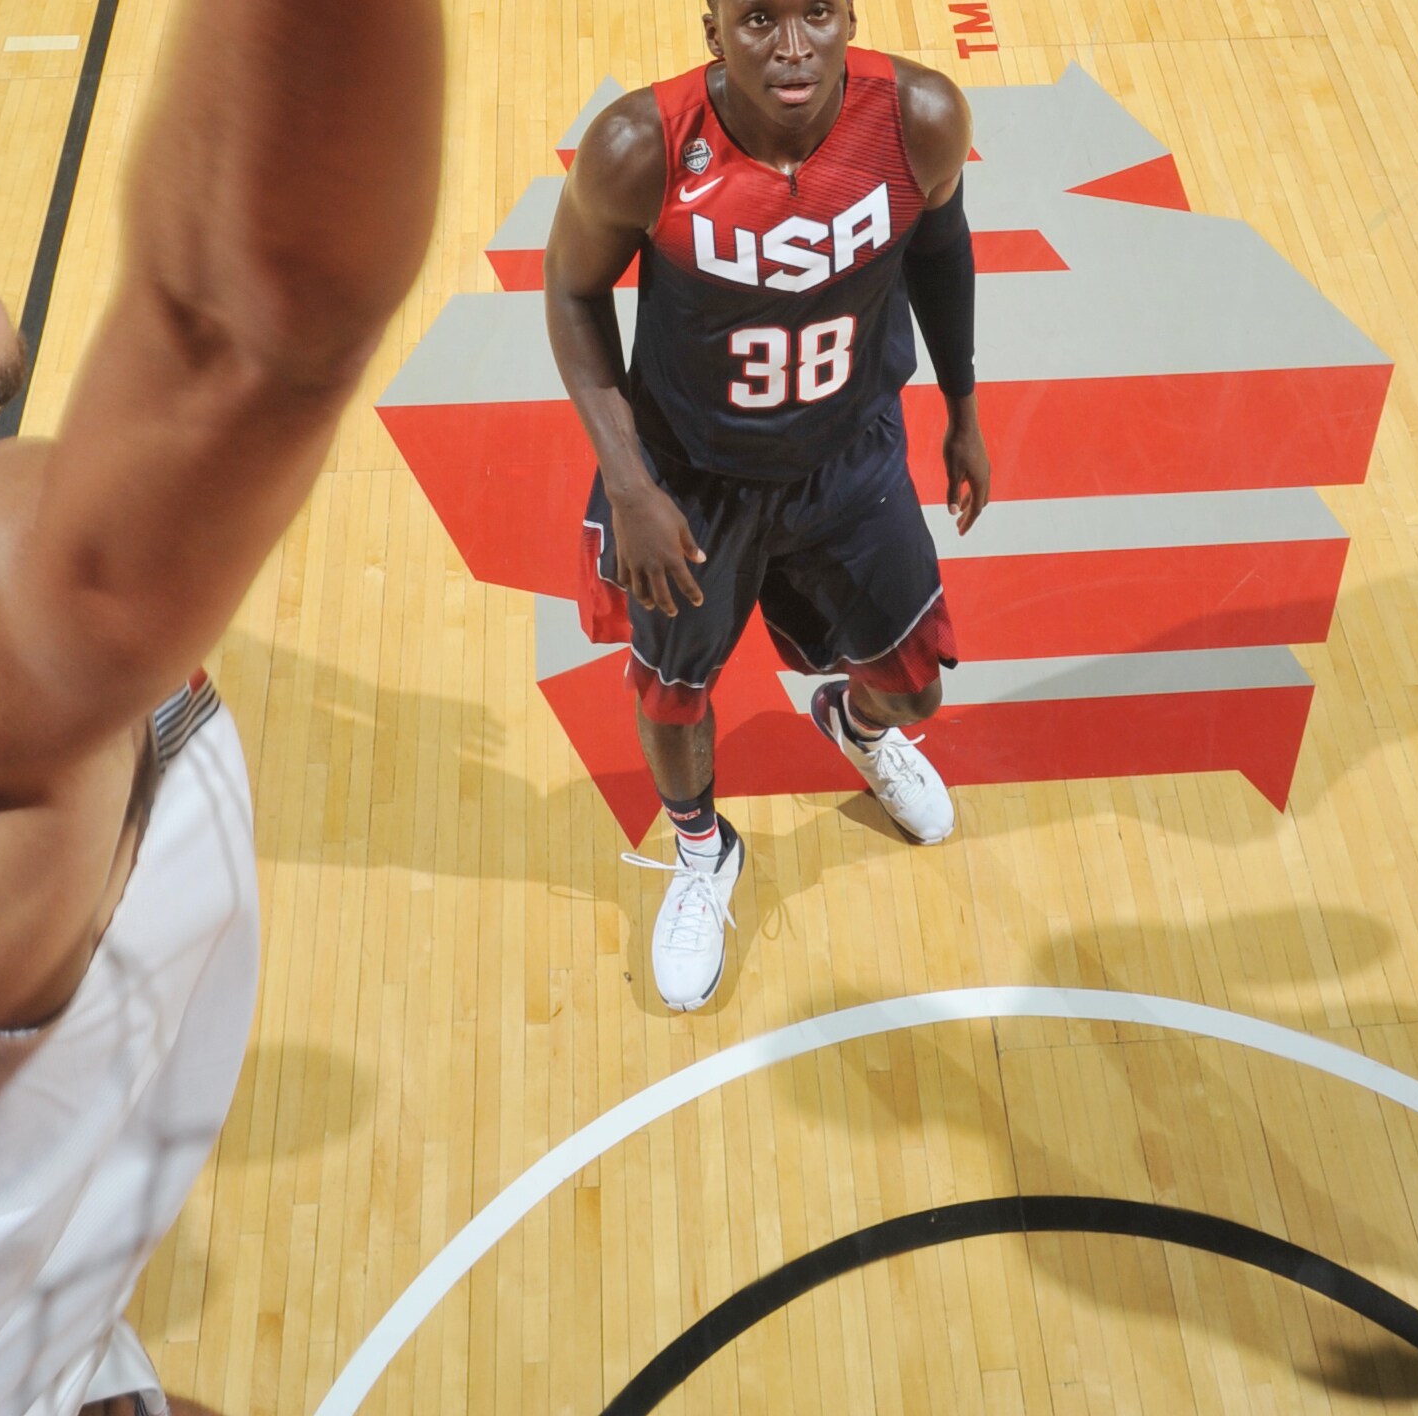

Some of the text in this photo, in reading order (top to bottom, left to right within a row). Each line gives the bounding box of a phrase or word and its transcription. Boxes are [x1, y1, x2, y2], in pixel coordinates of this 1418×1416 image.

[948, 2, 998, 59] TM
[691, 182, 892, 294] USA
[728, 314, 856, 409] 38
